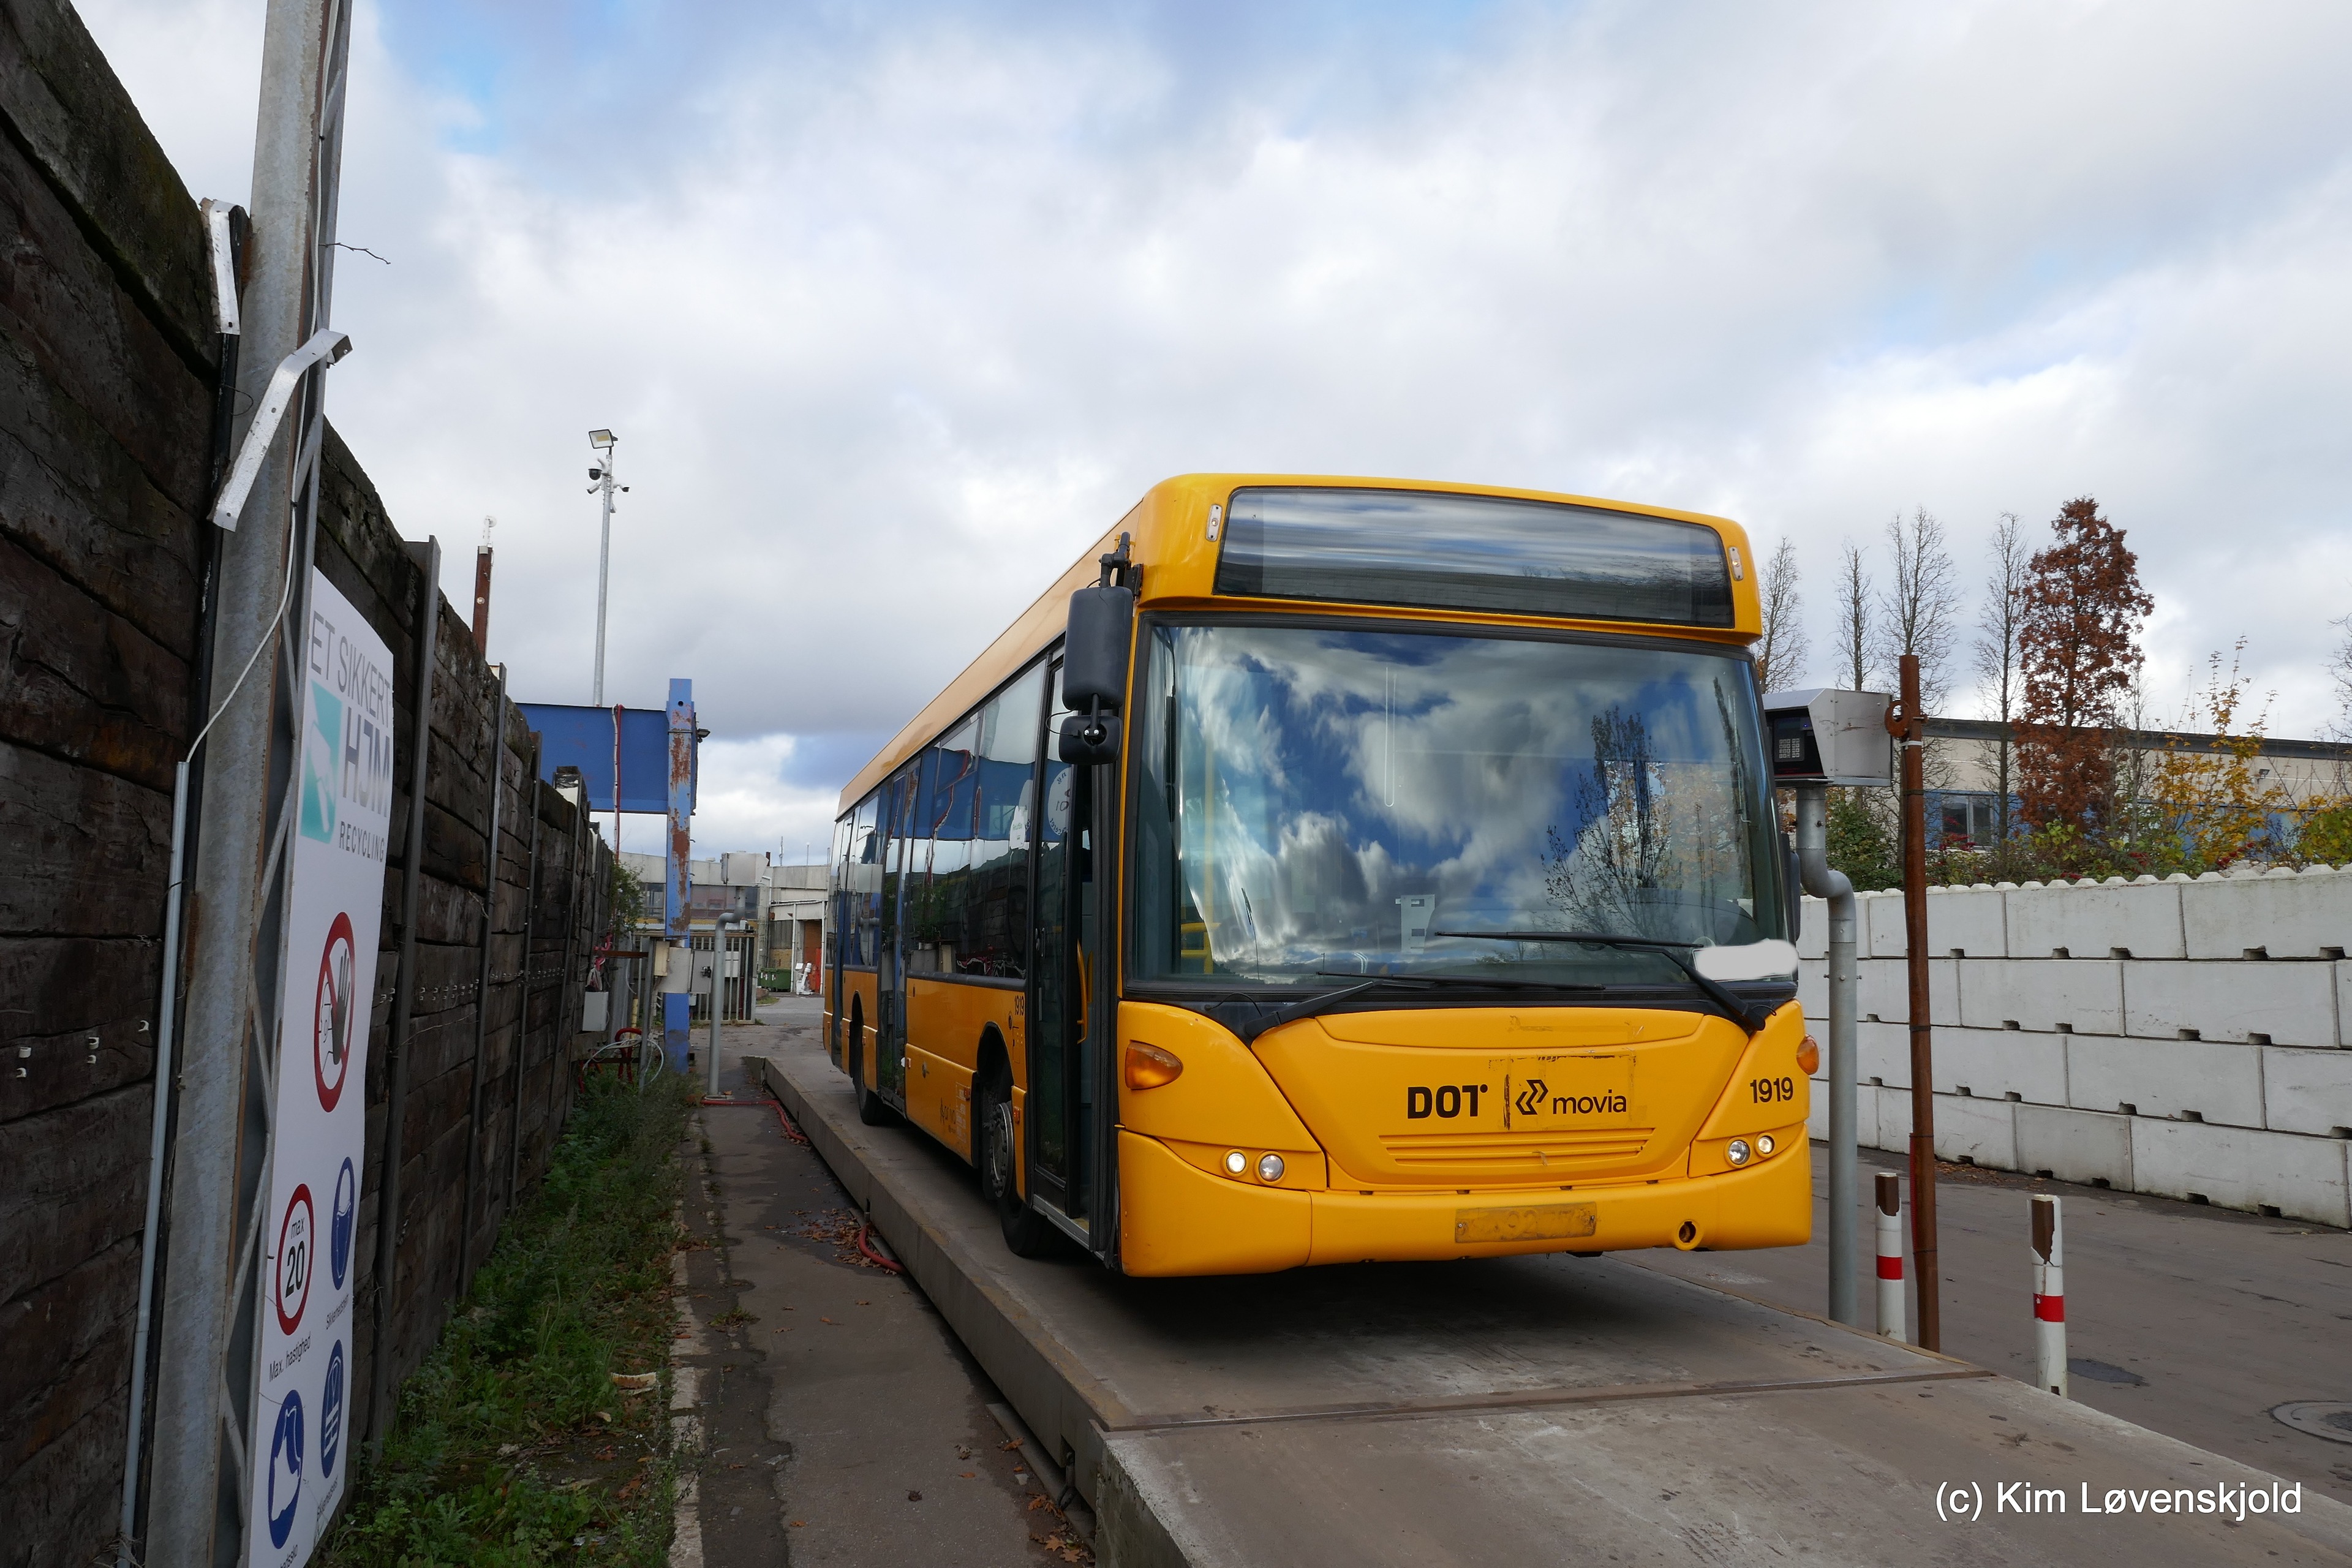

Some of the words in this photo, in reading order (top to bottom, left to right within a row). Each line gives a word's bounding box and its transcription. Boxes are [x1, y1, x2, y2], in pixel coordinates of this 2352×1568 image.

[311, 611, 335, 680] ET
[338, 636, 391, 728] SIKKERT
[343, 706, 390, 817] HJM
[339, 821, 385, 862] RECYCLING
[1014, 995, 1025, 1016] 1919
[1408, 1084, 1487, 1119] DOT
[1553, 1089, 1627, 1114] movia
[1750, 1077, 1793, 1103] 1919
[290, 1217, 305, 1240] max
[285, 1240, 305, 1298] 20
[270, 1359, 284, 1382] Max.
[285, 1330, 311, 1369] hastighed
